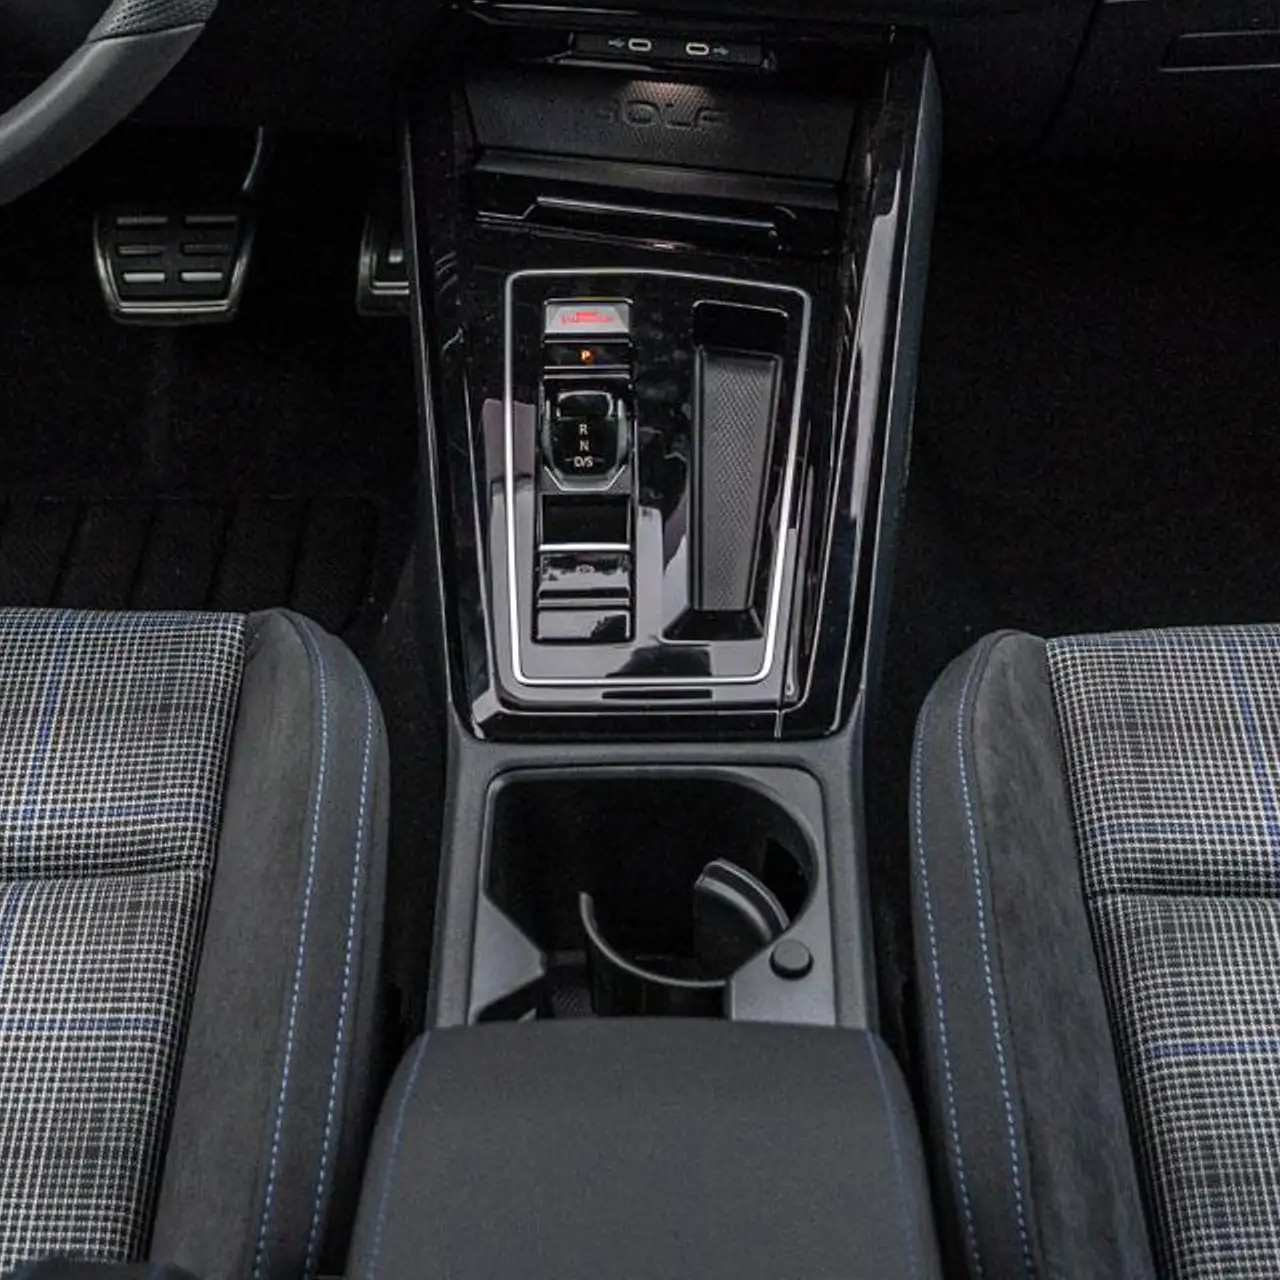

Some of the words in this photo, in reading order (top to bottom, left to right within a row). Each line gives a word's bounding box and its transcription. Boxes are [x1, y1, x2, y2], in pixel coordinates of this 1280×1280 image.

[581, 350, 592, 361] P
[578, 423, 589, 436] R
[579, 443, 590, 455] N
[573, 457, 594, 469] D/S
